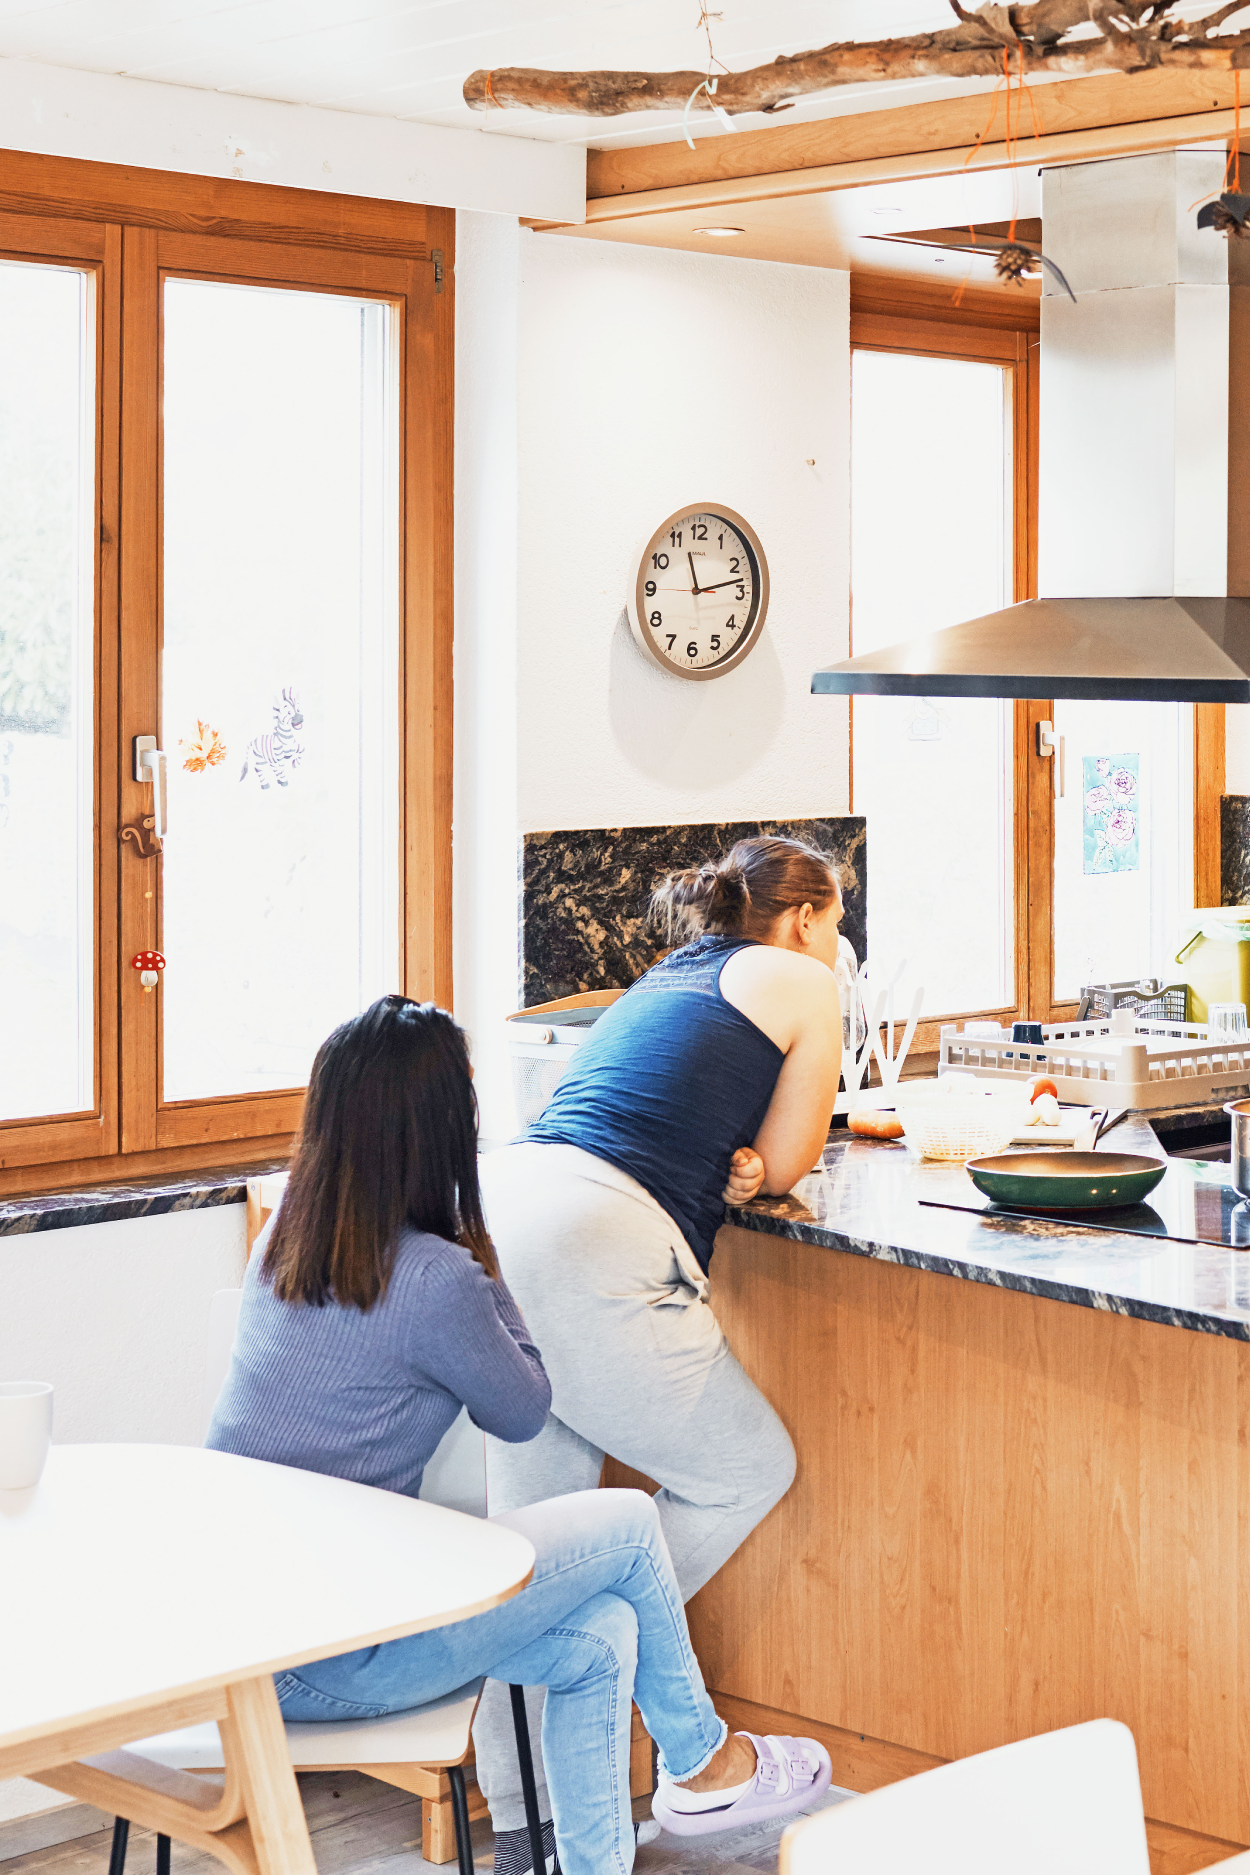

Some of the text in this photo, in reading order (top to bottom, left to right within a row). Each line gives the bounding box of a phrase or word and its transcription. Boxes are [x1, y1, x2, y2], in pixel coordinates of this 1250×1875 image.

[670, 530, 682, 547] 11
[690, 524, 708, 540] 12
[718, 533, 724, 549] 1
[652, 552, 669, 569] 10
[729, 557, 740, 573] 2
[645, 580, 657, 597] 9
[735, 584, 745, 600] 3
[649, 610, 662, 627] 8
[725, 614, 736, 630] 4
[665, 634, 677, 650] 7
[686, 641, 698, 657] 6
[710, 634, 720, 650] 5
